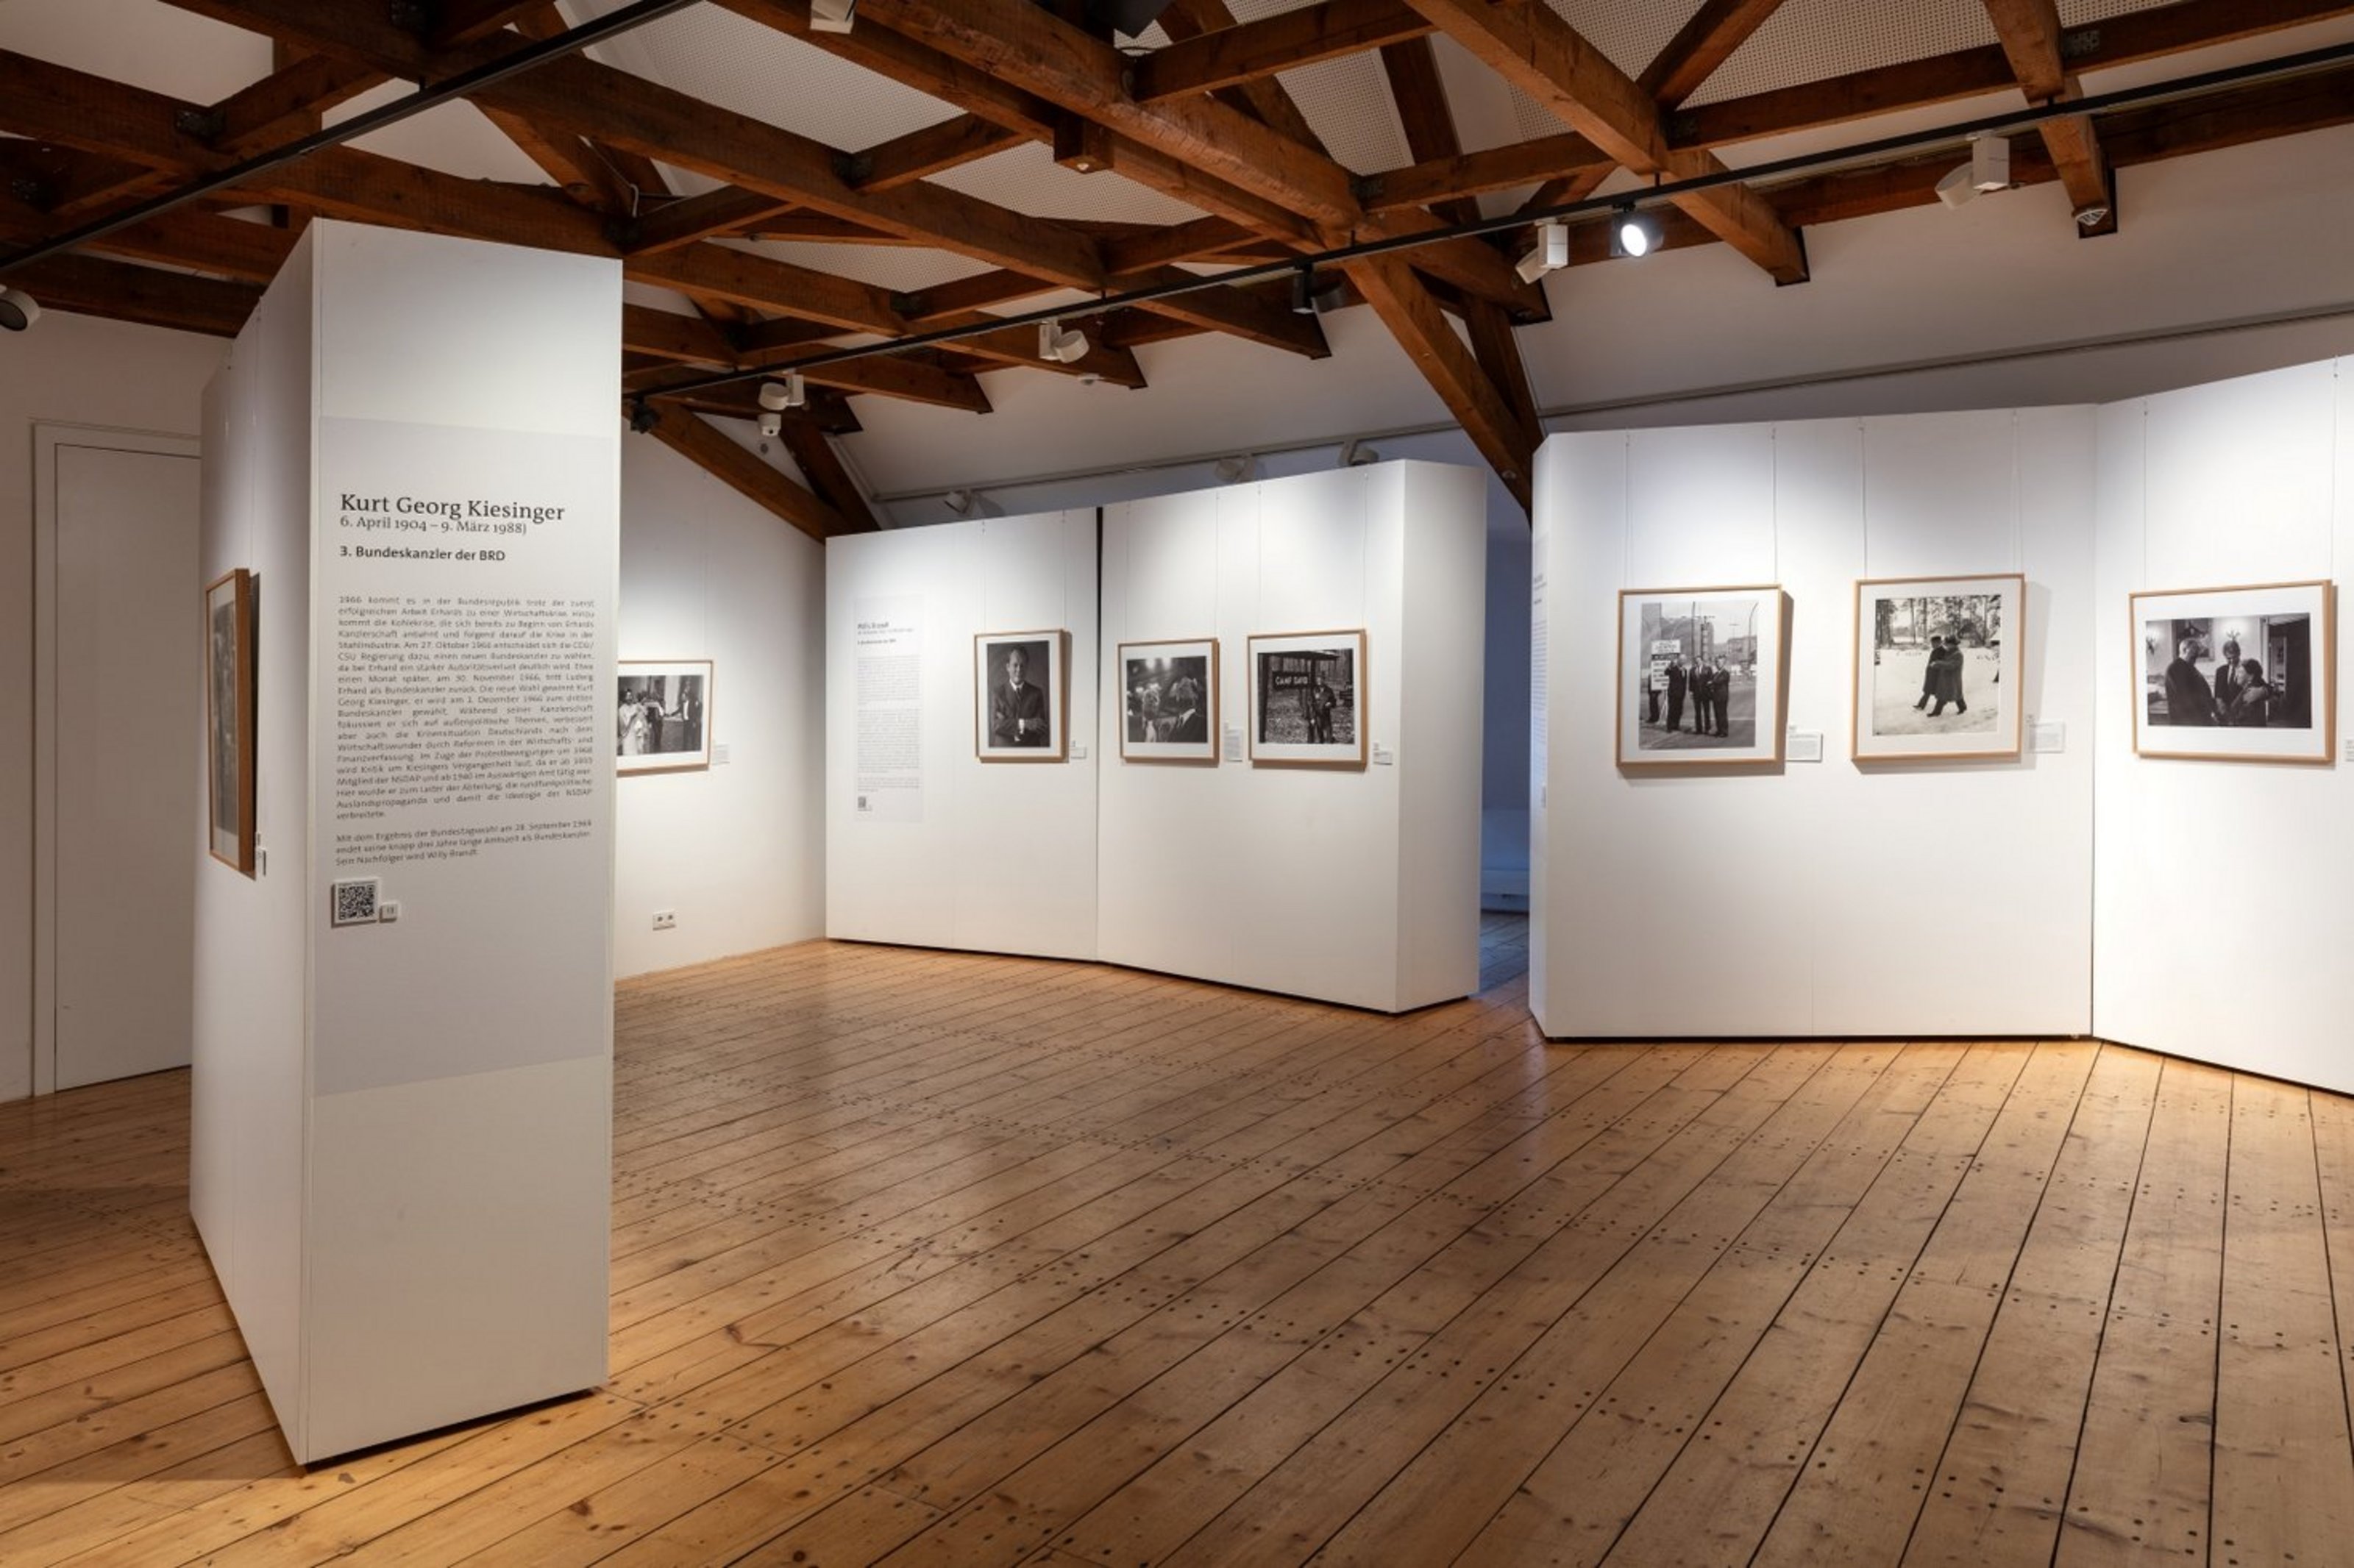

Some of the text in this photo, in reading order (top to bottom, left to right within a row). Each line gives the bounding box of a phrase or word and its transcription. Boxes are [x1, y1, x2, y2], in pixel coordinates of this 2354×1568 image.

[341, 493, 565, 524] Kurt Georg Kiesinger
[340, 515, 353, 527] 6.
[356, 516, 391, 531] April
[395, 519, 427, 532] 1904
[441, 521, 454, 533] 9.
[457, 521, 490, 532] März
[493, 523, 527, 535] 1988)
[340, 546, 506, 560] 3. Bundeskanzler der BRD
